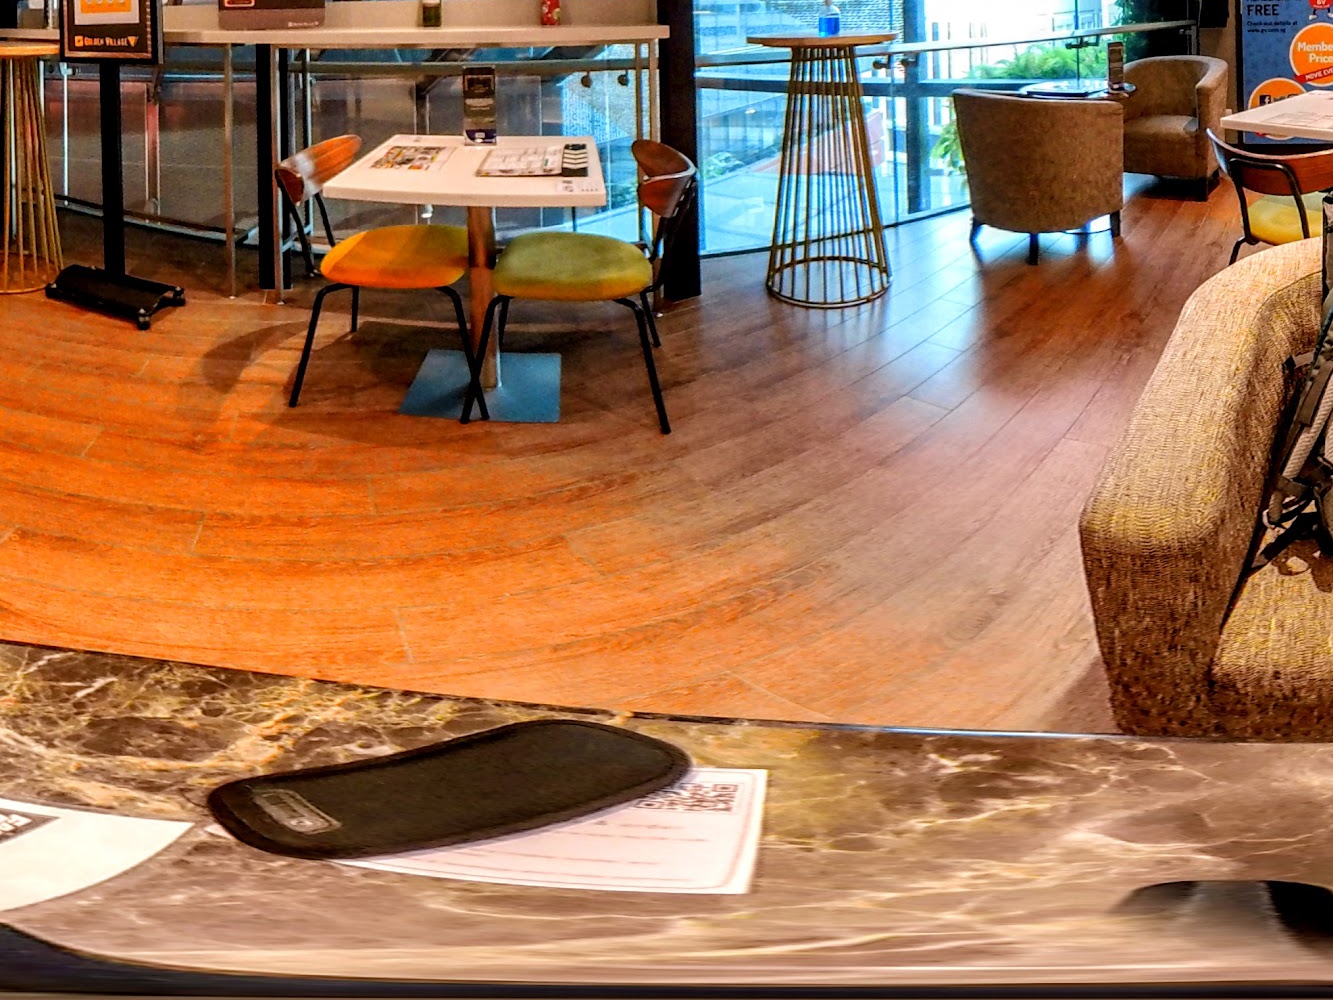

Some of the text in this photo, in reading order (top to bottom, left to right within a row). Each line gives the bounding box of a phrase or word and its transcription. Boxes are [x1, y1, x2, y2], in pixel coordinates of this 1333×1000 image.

[1247, 4, 1280, 16] FREE
[105, 36, 128, 47] VILLAGE
[1309, 53, 1333, 63] Price
[1305, 69, 1323, 81] MOVIE
